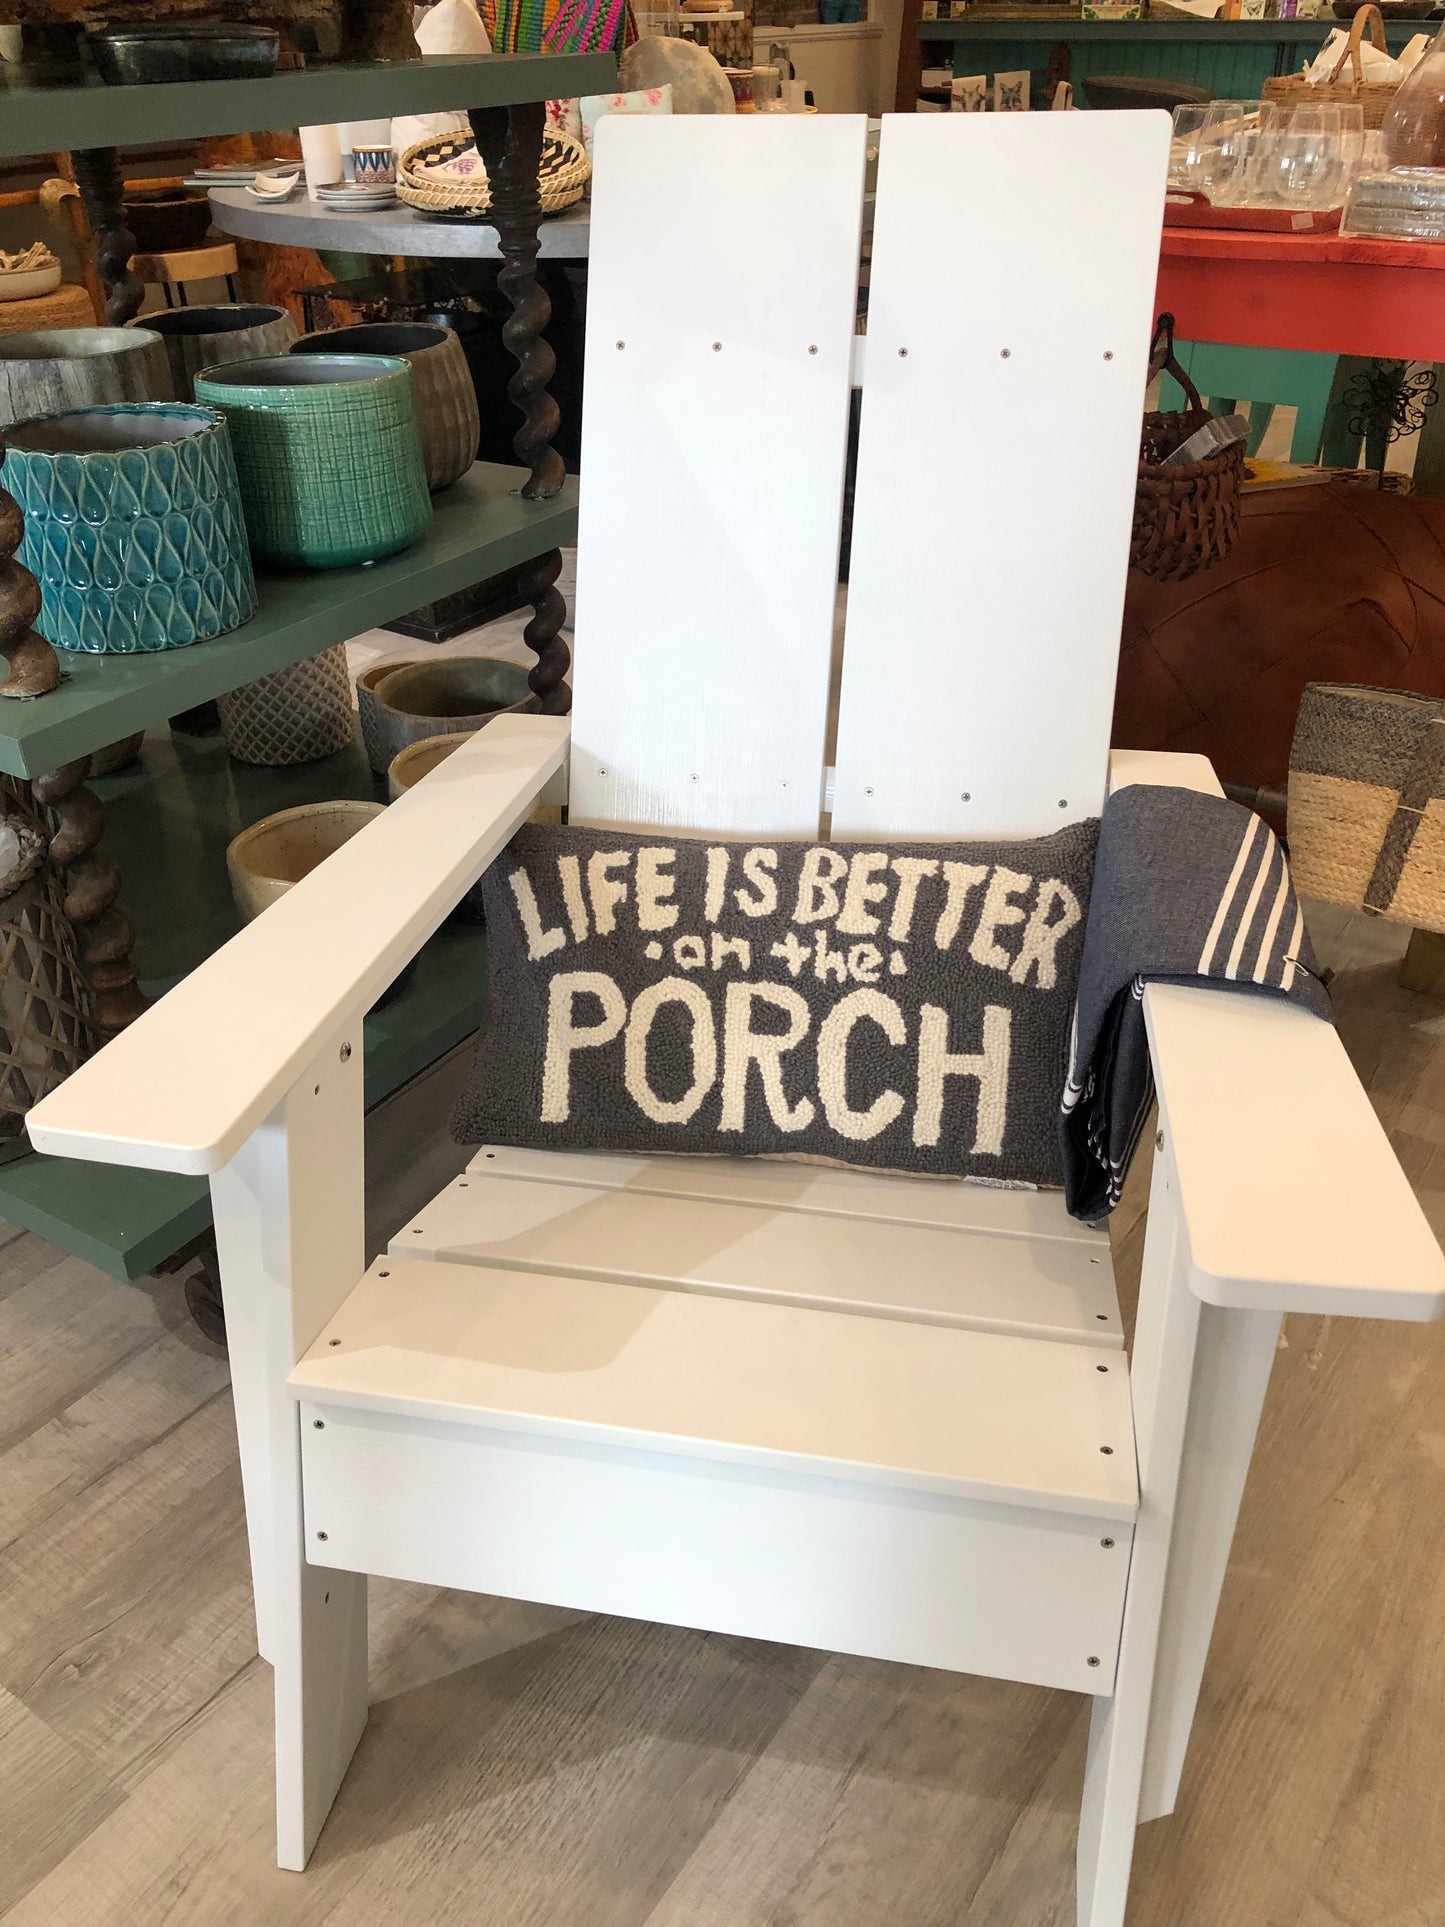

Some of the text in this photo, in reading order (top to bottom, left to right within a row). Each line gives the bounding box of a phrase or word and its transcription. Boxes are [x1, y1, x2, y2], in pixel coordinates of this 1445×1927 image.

[509, 846, 1081, 990] LIFE IS BETTER
[539, 971, 1012, 1157] PORCH
